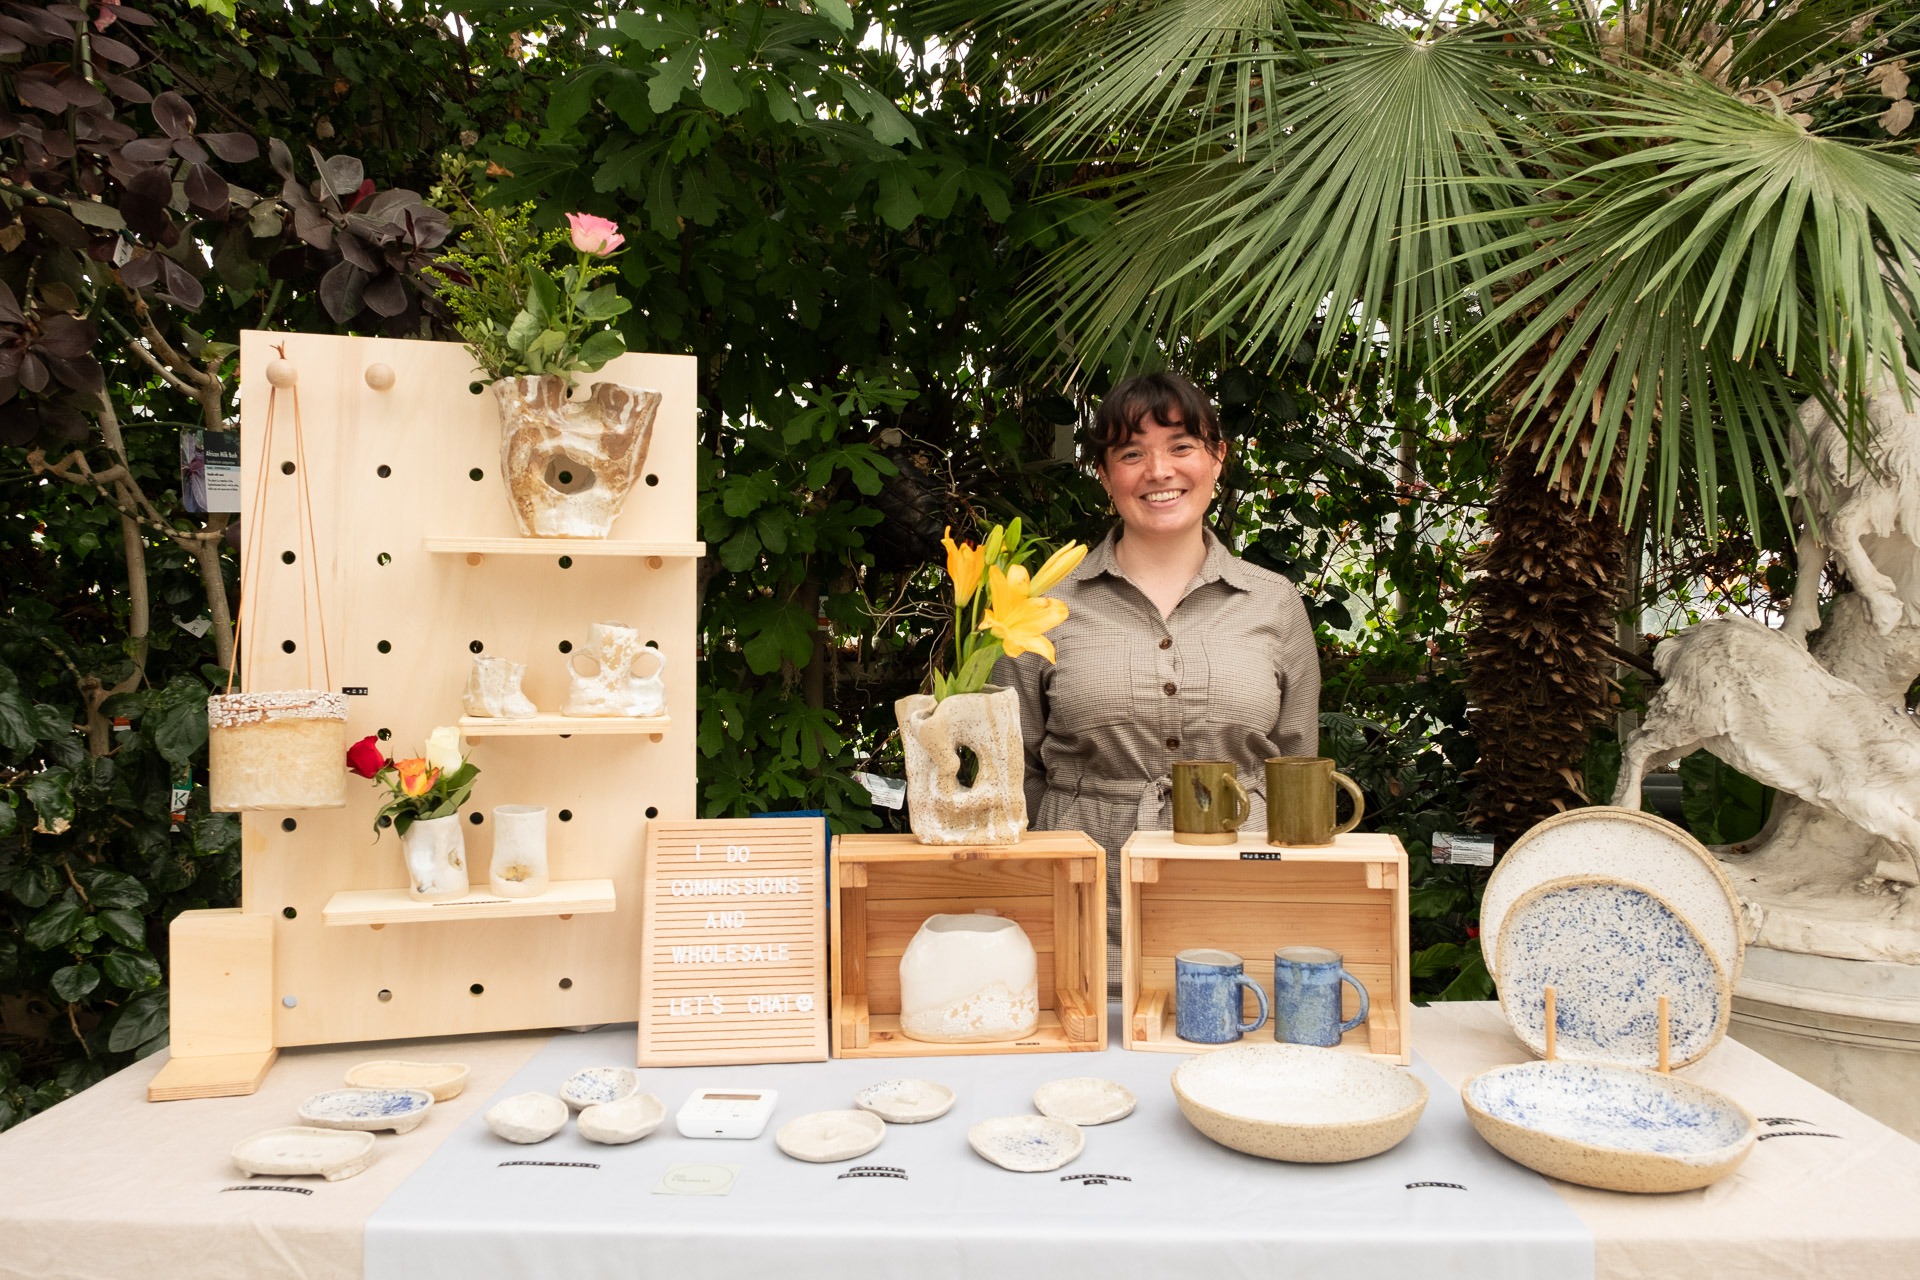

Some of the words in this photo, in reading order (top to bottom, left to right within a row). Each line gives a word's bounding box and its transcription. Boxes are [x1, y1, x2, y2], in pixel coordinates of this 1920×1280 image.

[174, 791, 187, 806] K
[695, 844, 701, 862] I
[726, 845, 750, 863] DO
[671, 876, 801, 897] COMMISSIONS
[705, 910, 745, 929] AND
[672, 943, 789, 964] WHOLESALE
[669, 993, 724, 1016] LET'S
[748, 995, 790, 1014] CHAT
